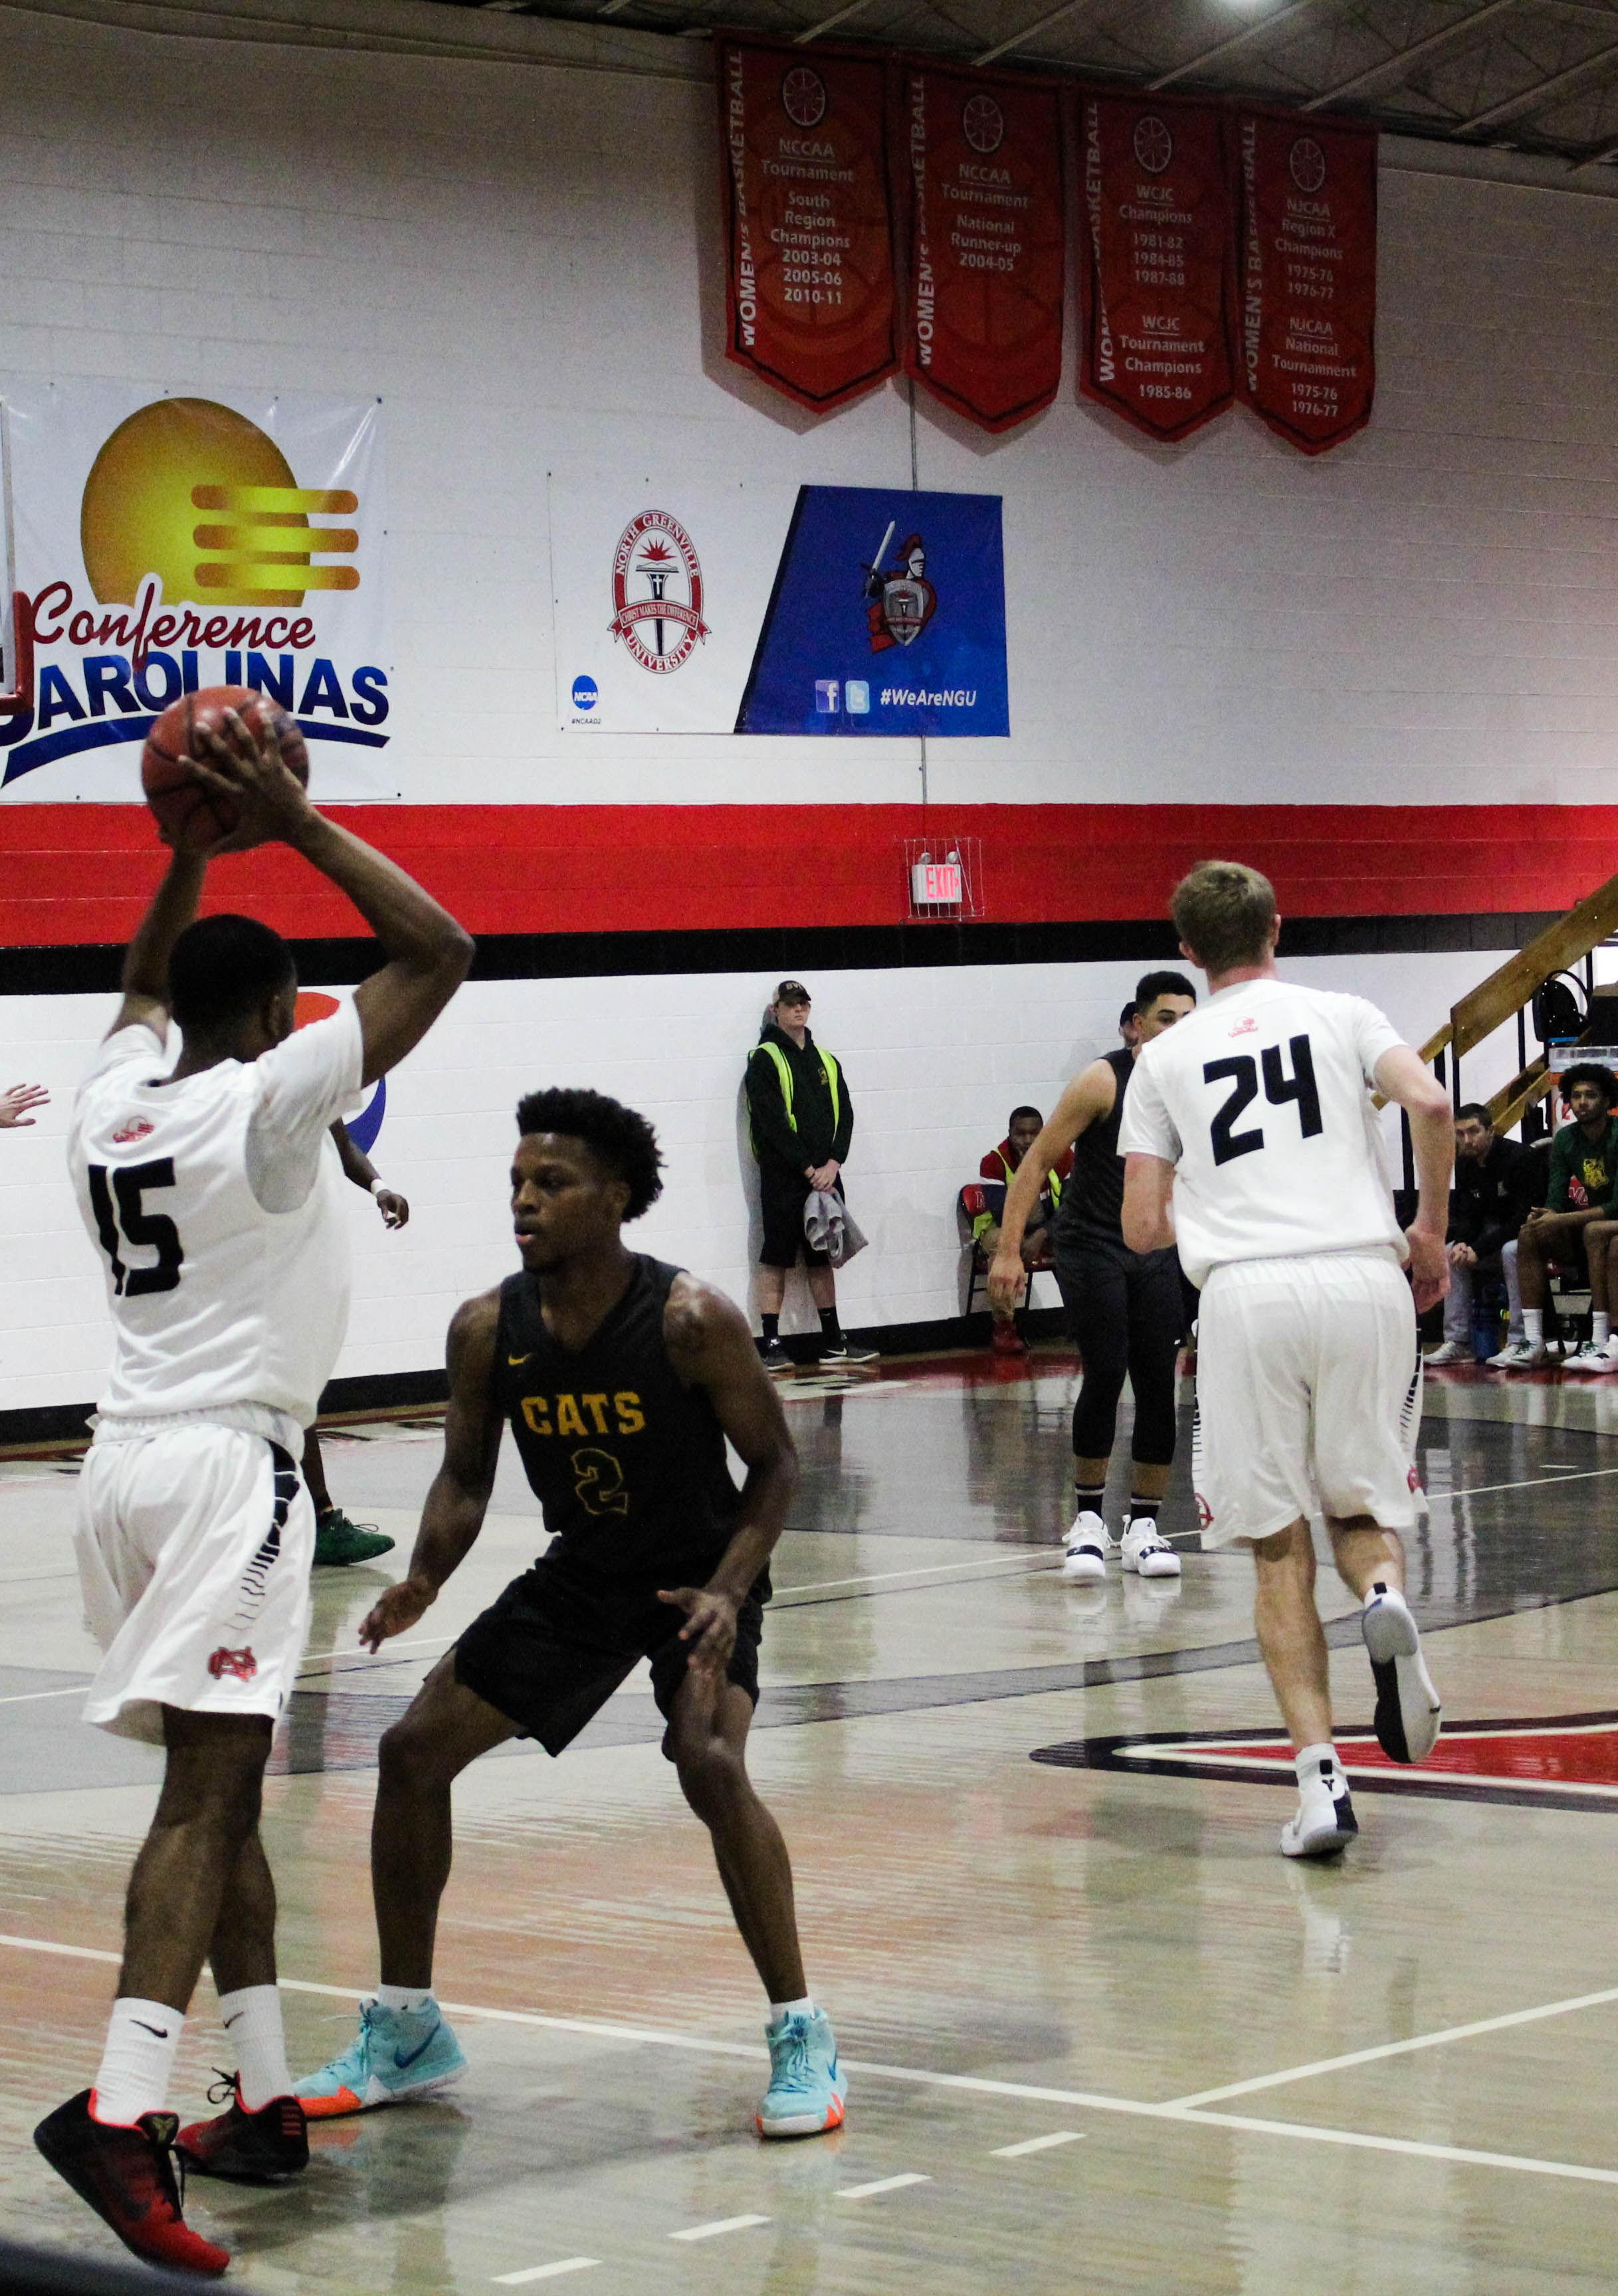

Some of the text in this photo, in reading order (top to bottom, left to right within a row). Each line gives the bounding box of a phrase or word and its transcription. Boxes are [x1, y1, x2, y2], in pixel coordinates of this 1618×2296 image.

[779, 138, 835, 157] NCCAA
[761, 159, 854, 183] Tournament
[960, 164, 1011, 184] NCCAA
[789, 191, 831, 208] South
[941, 183, 1029, 208] Tournament
[1119, 205, 1192, 225] Champions
[1287, 199, 1330, 217] NJCAA
[785, 211, 835, 230] Region
[957, 214, 1015, 233] National
[1282, 219, 1325, 237] Region
[770, 229, 850, 249] Champions
[952, 232, 1021, 256] Runner-up
[1133, 233, 1183, 248] 1981-82
[1275, 237, 1343, 260] Champions
[782, 249, 841, 266] 2003-04
[960, 252, 1014, 271] 2004-05
[739, 223, 757, 345] WOMEN'S
[783, 268, 842, 286] 2005-06
[1135, 270, 1185, 285] 1987-88
[784, 288, 842, 304] 2010-11
[1142, 315, 1180, 331] WCJC
[1290, 317, 1333, 335] NJCAA
[1119, 335, 1205, 353] Tournament
[1286, 336, 1339, 356] National
[1125, 357, 1202, 377] Champions
[1140, 385, 1191, 399] 1985-86
[1292, 383, 1338, 400] 1975-76
[1292, 400, 1338, 417] 1976-77
[615, 514, 699, 577] NORTH GREENVILLE
[33, 581, 316, 671] Conference
[627, 634, 694, 670] UNIVERSITY
[573, 692, 598, 702] NCAA
[880, 689, 977, 707] #WeAreNGU
[926, 866, 956, 899] EXIT
[1203, 1034, 1323, 1166] 24
[88, 1157, 184, 1297] 15
[521, 1391, 646, 1435] CATS
[571, 1448, 629, 1515] 2
